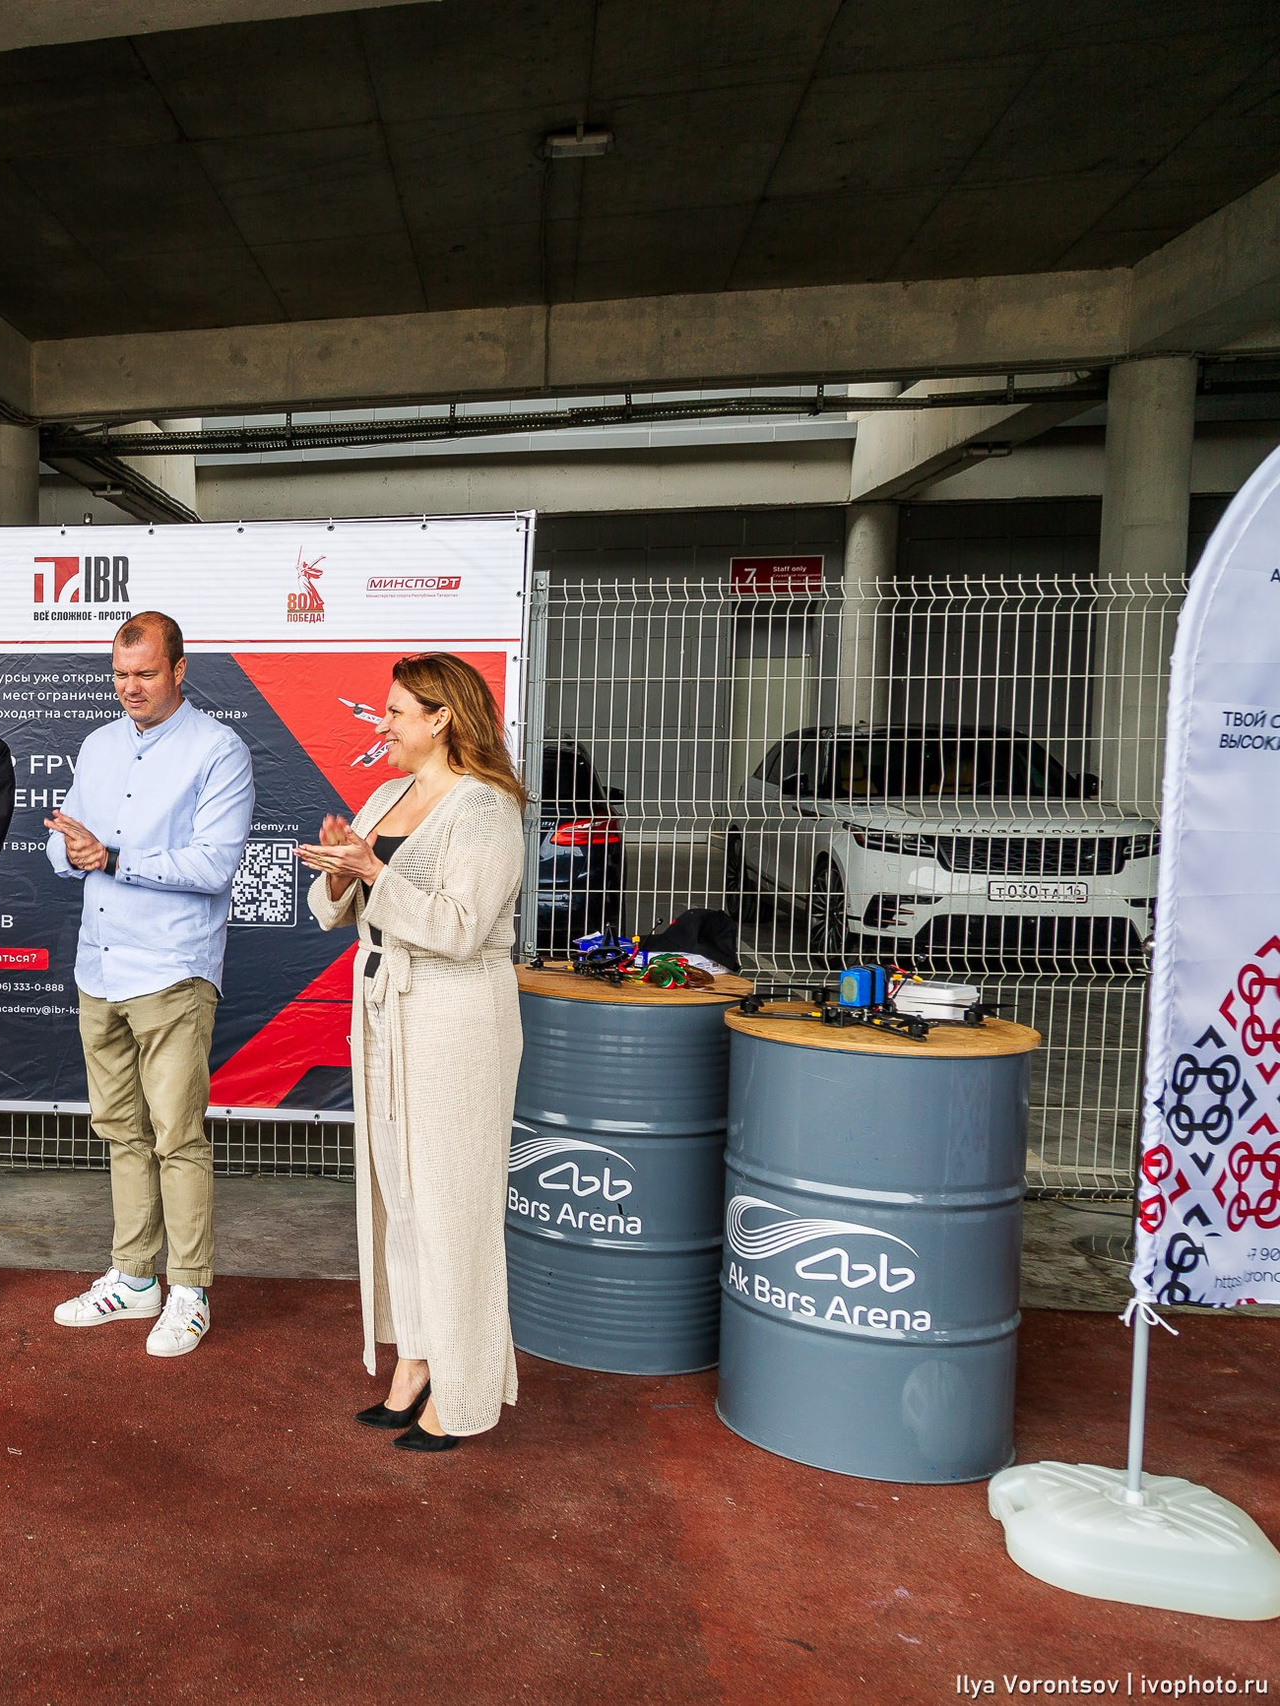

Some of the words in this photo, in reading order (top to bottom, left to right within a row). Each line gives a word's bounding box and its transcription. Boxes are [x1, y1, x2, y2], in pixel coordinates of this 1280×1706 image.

[791, 565, 807, 573] only
[84, 556, 130, 602] IBR
[744, 568, 757, 584] 7
[369, 578, 460, 589] МИНСПОРТ
[287, 592, 308, 610] 80
[33, 610, 50, 621] ВСЁ
[51, 611, 92, 621] СЛОЖНОЕ
[98, 611, 132, 621] ПРОСТО
[286, 613, 325, 624] ПОБЕДА!
[32, 674, 60, 686] уже
[3, 692, 35, 701] мест
[45, 710, 61, 719] на
[63, 709, 128, 721] стадионе
[200, 708, 248, 720] рена»
[1222, 710, 1267, 728] ТВОЙ
[1219, 733, 1280, 751] ВЫСОК
[14, 788, 67, 808] ЕНЕ
[251, 822, 299, 833] demy.ru
[11, 841, 46, 854] взро
[13, 982, 64, 992] 333-0-888
[508, 1186, 551, 1222] Bars
[556, 1202, 642, 1236] Arena
[1260, 1247, 1280, 1262] 90
[727, 1261, 750, 1296] Ak
[754, 1273, 817, 1318] Bars
[824, 1294, 932, 1332] Arena
